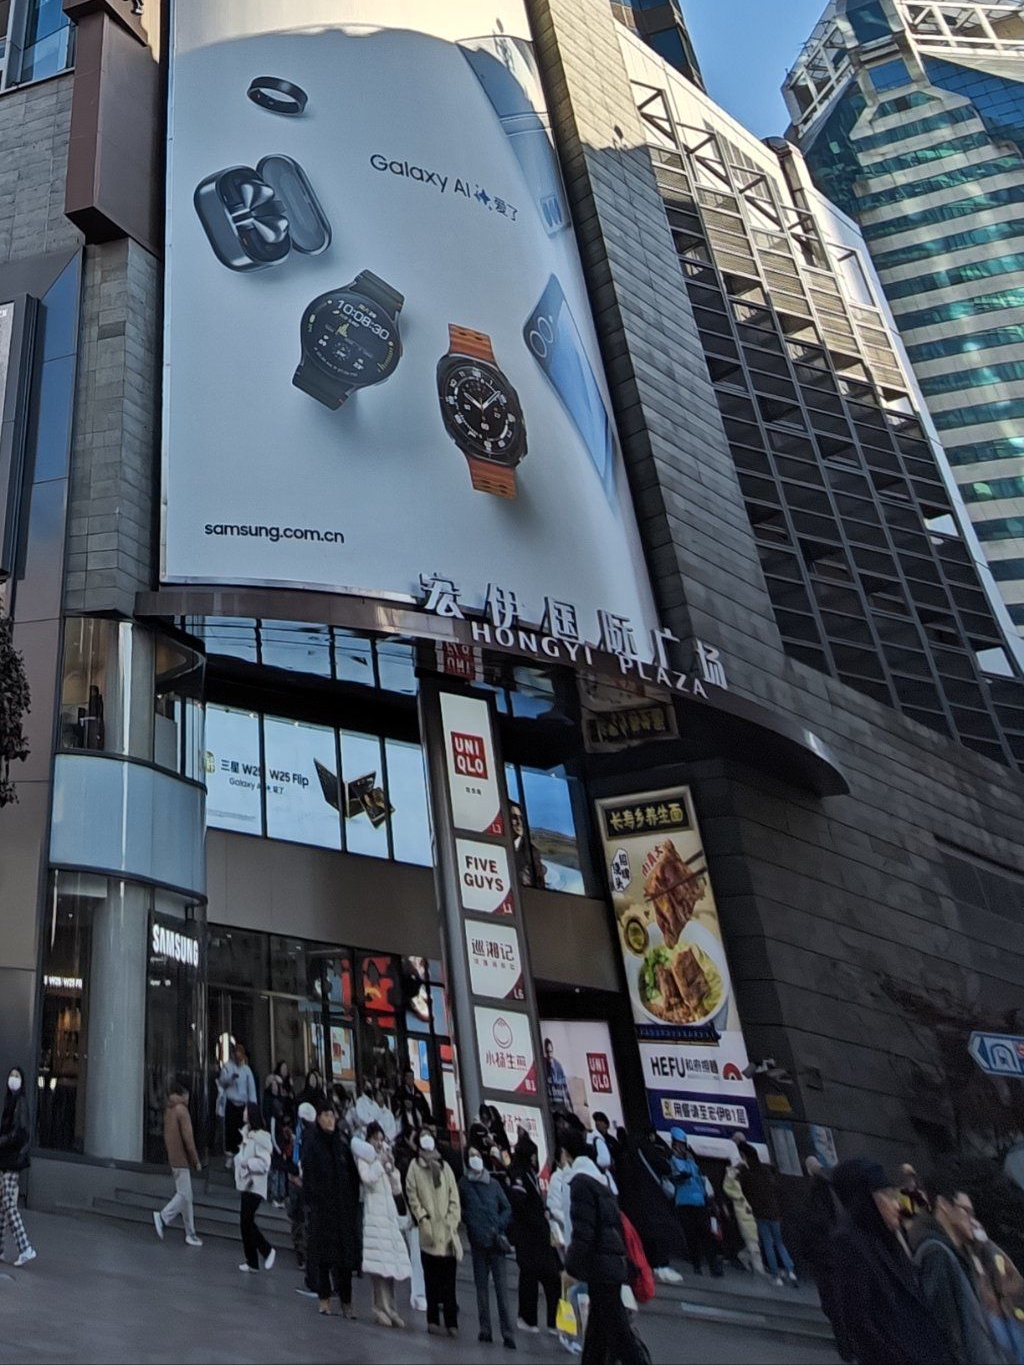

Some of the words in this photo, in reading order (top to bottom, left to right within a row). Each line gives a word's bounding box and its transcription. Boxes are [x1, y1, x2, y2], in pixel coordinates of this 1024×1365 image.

[370, 154, 448, 193] Galaxy
[454, 178, 471, 198] AI
[337, 300, 389, 340] 10:08:30
[205, 524, 344, 543] samsung.com.cn
[419, 572, 728, 690] 宏伊国际广场
[471, 621, 593, 665] HONGYI
[618, 652, 709, 699] PLAZA
[454, 736, 480, 756] UNI
[220, 759, 240, 774] 三星
[270, 769, 291, 783] W25
[292, 772, 309, 788] Flip
[456, 755, 484, 774] QLO
[229, 777, 256, 792] Galaxy
[465, 855, 498, 874] FIVE
[464, 873, 504, 892] GUYS
[152, 924, 199, 968] SAMSUNG
[589, 1057, 606, 1074] UNI
[650, 1057, 686, 1078] HEFU
[591, 1073, 610, 1090] QLO
